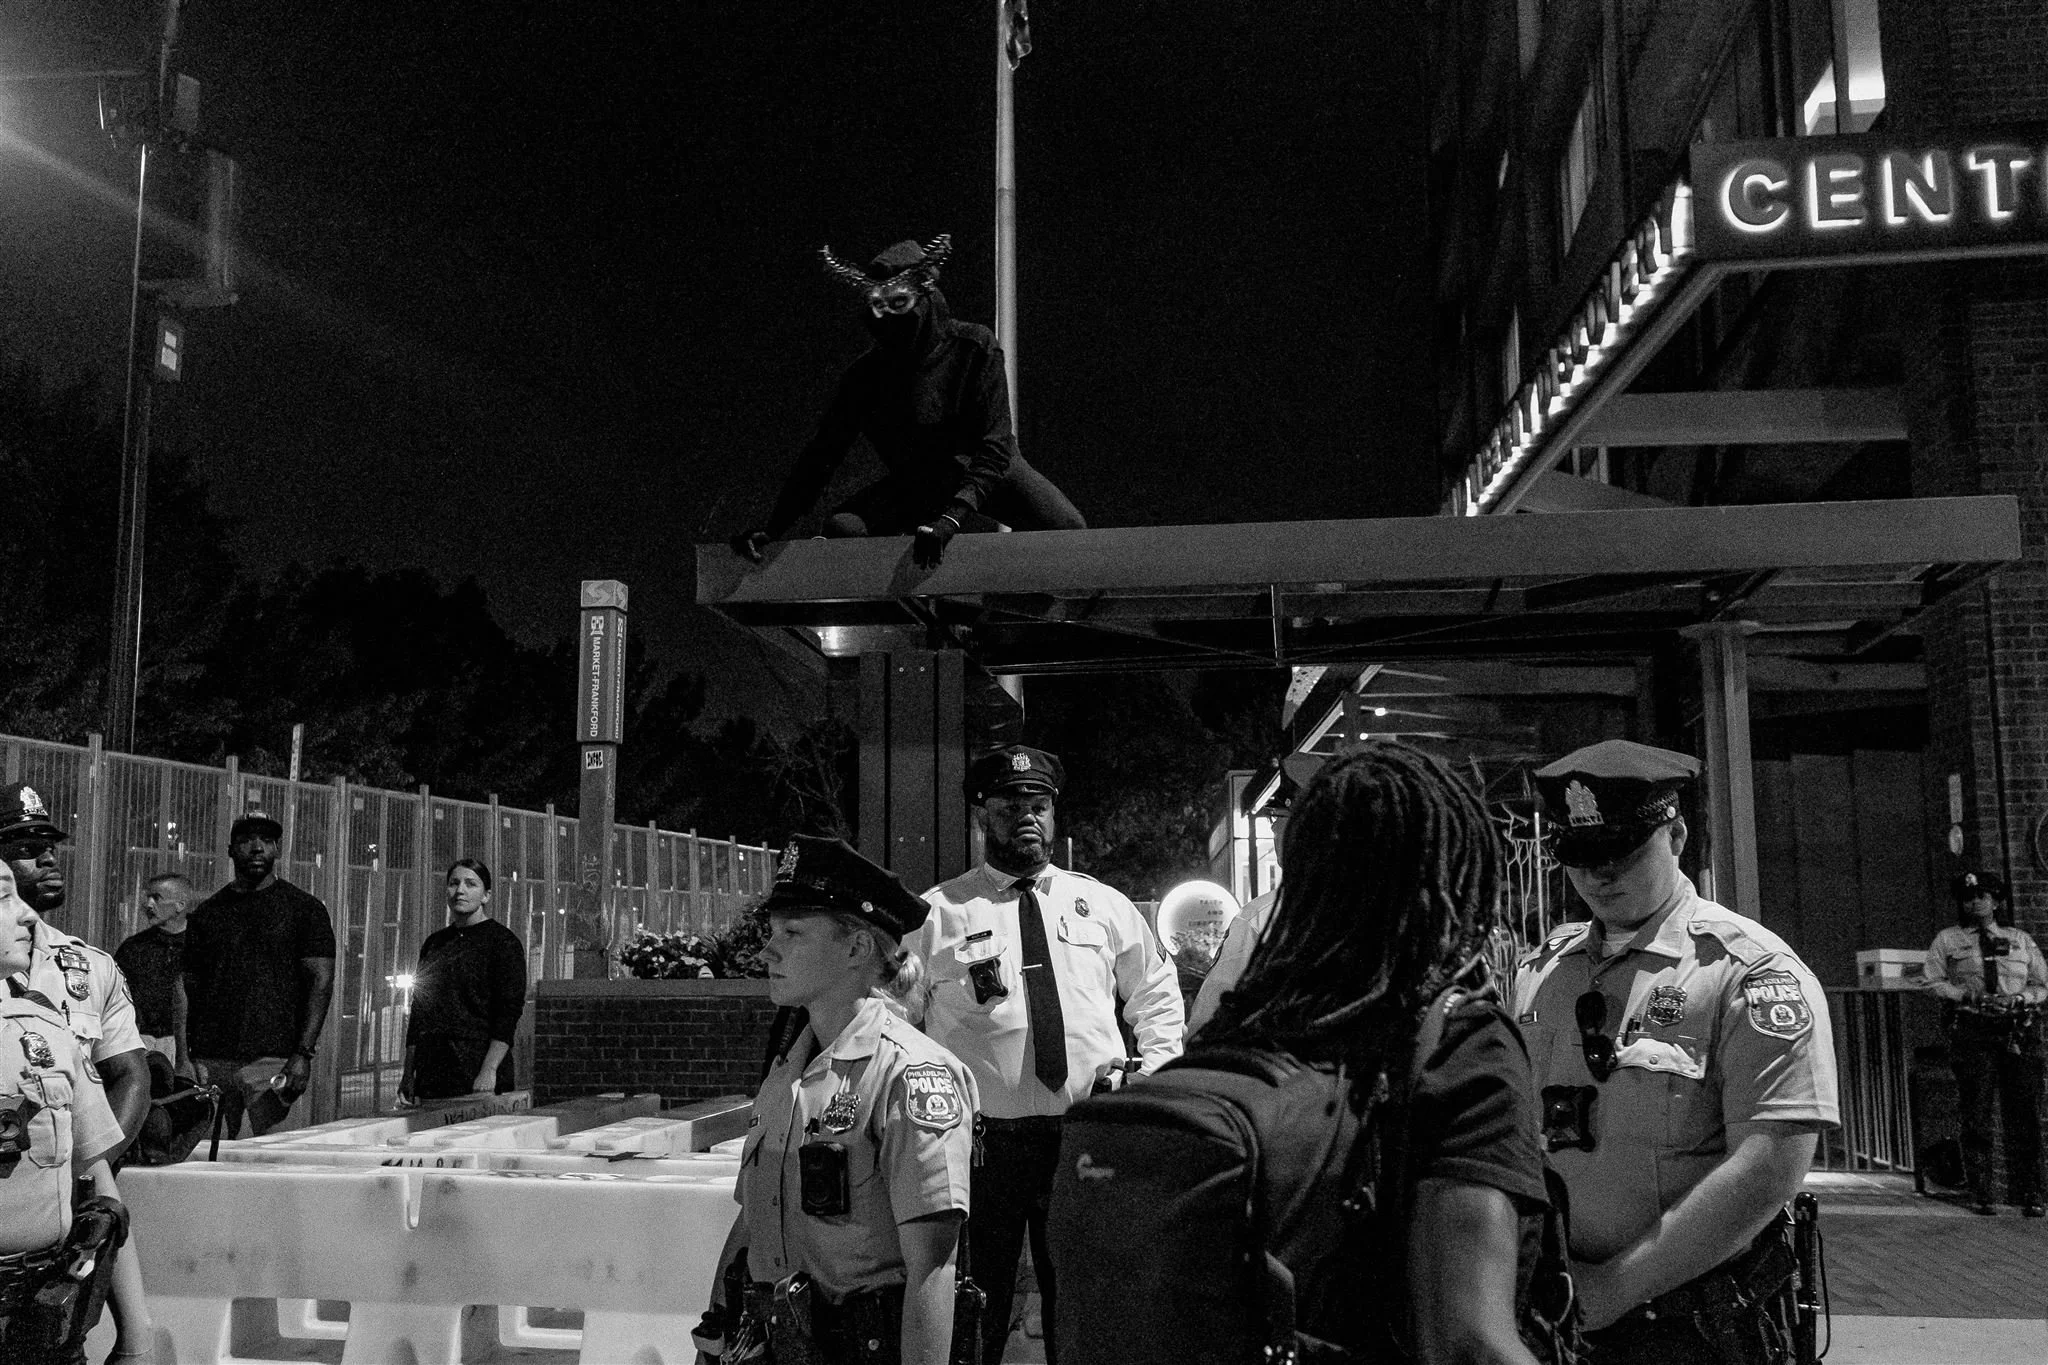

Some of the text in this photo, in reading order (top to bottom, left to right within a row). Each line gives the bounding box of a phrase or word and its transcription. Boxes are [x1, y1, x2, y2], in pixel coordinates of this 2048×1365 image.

[1721, 147, 2048, 233] CENT
[590, 637, 601, 737] MARKET-FRANKFORD
[1749, 985, 1800, 1004] POLICE
[909, 1077, 953, 1095] POLICE
